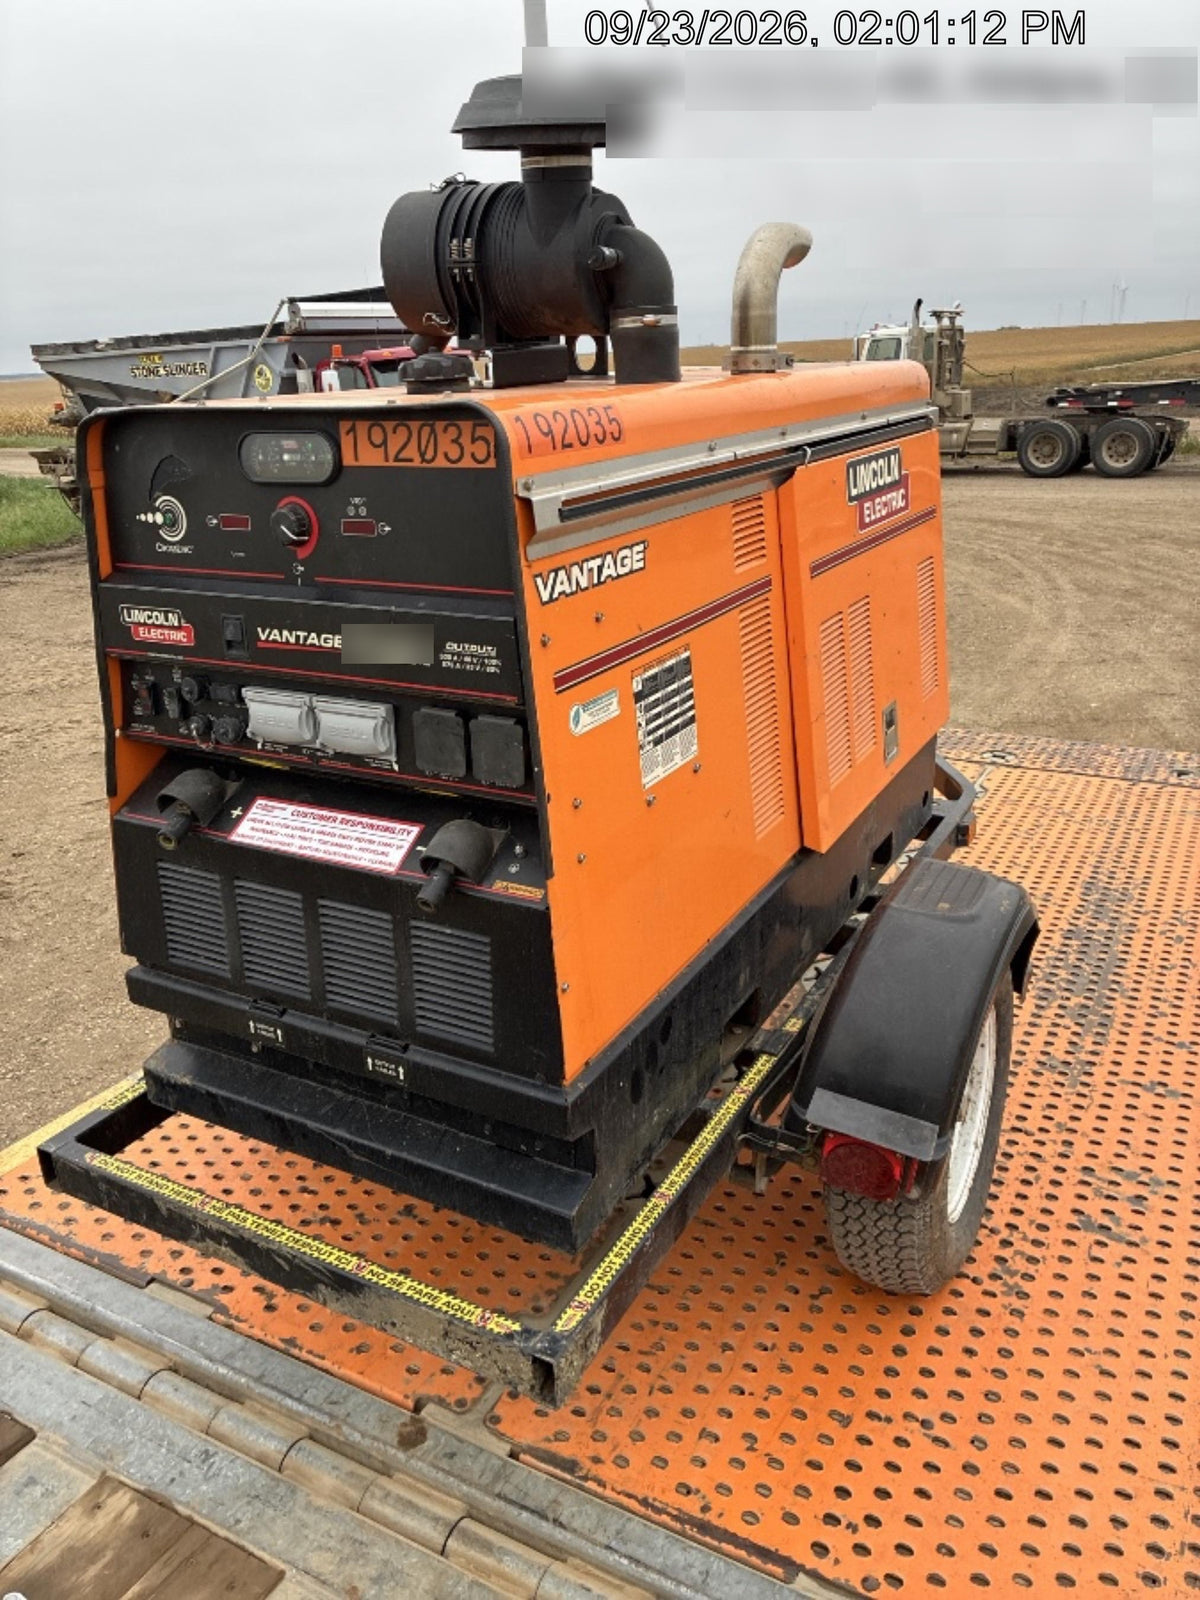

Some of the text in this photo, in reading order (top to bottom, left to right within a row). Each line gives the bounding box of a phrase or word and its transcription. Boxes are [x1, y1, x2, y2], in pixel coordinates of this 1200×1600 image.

[130, 362, 207, 379] STONE SLINGER
[515, 405, 622, 455] 192035
[849, 453, 899, 496] LINCOLN
[864, 488, 906, 523] ELECTRIC
[534, 542, 645, 605] VANTAGE
[123, 607, 180, 627] LINCOLN
[138, 626, 188, 643] ELECTRIC
[257, 626, 342, 649] VANTAGE
[113, 1161, 137, 1179] NOT
[225, 1208, 250, 1226] PAS
[285, 1232, 338, 1260] DEBOUT
[335, 1253, 352, 1267] ICI
[367, 1268, 476, 1318] NO SE PARE AQUI
[584, 1283, 601, 1300] DO
[597, 1260, 617, 1282] NOT
